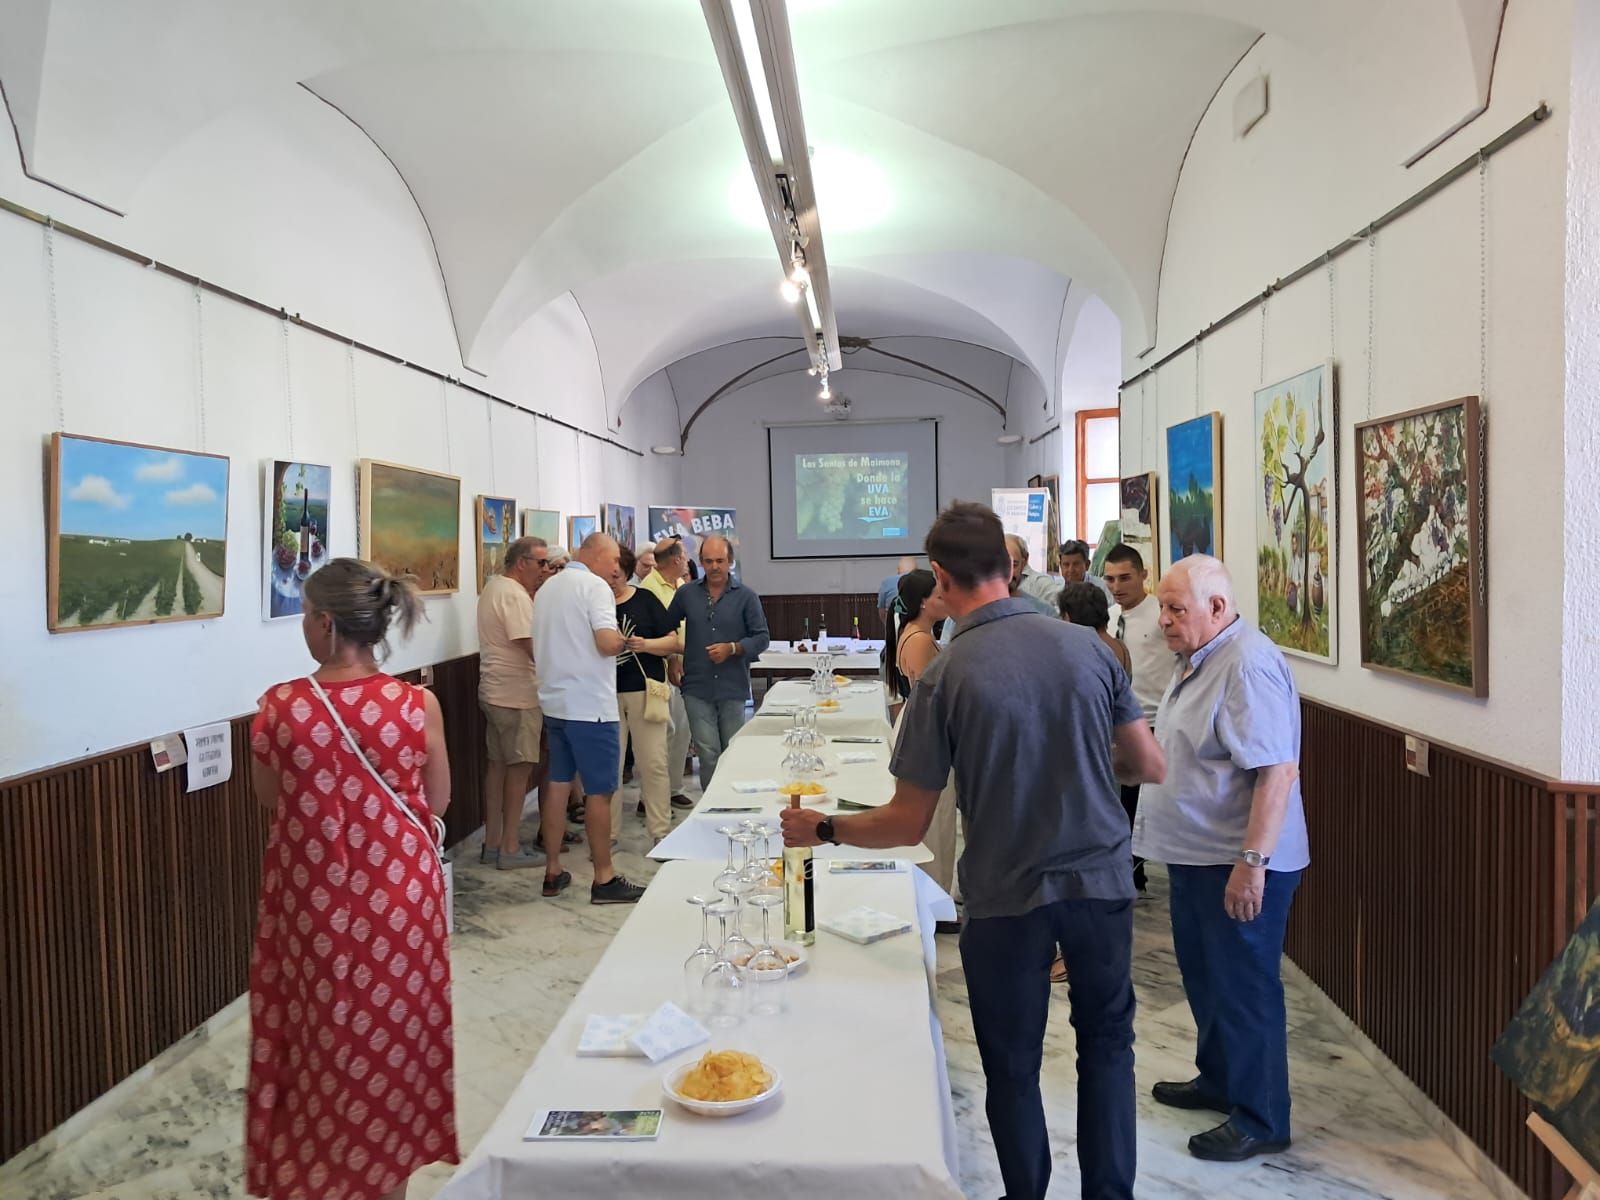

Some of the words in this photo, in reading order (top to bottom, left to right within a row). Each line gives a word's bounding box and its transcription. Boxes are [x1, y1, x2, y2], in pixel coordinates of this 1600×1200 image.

[818, 457, 845, 468] Santos
[848, 459, 858, 467] de
[861, 457, 901, 467] Maimona
[857, 472, 887, 483] Donde
[891, 472, 901, 482] la
[868, 484, 889, 494] UVA
[874, 495, 897, 504] hace
[869, 507, 888, 516] EVA
[691, 513, 735, 534] BEBA
